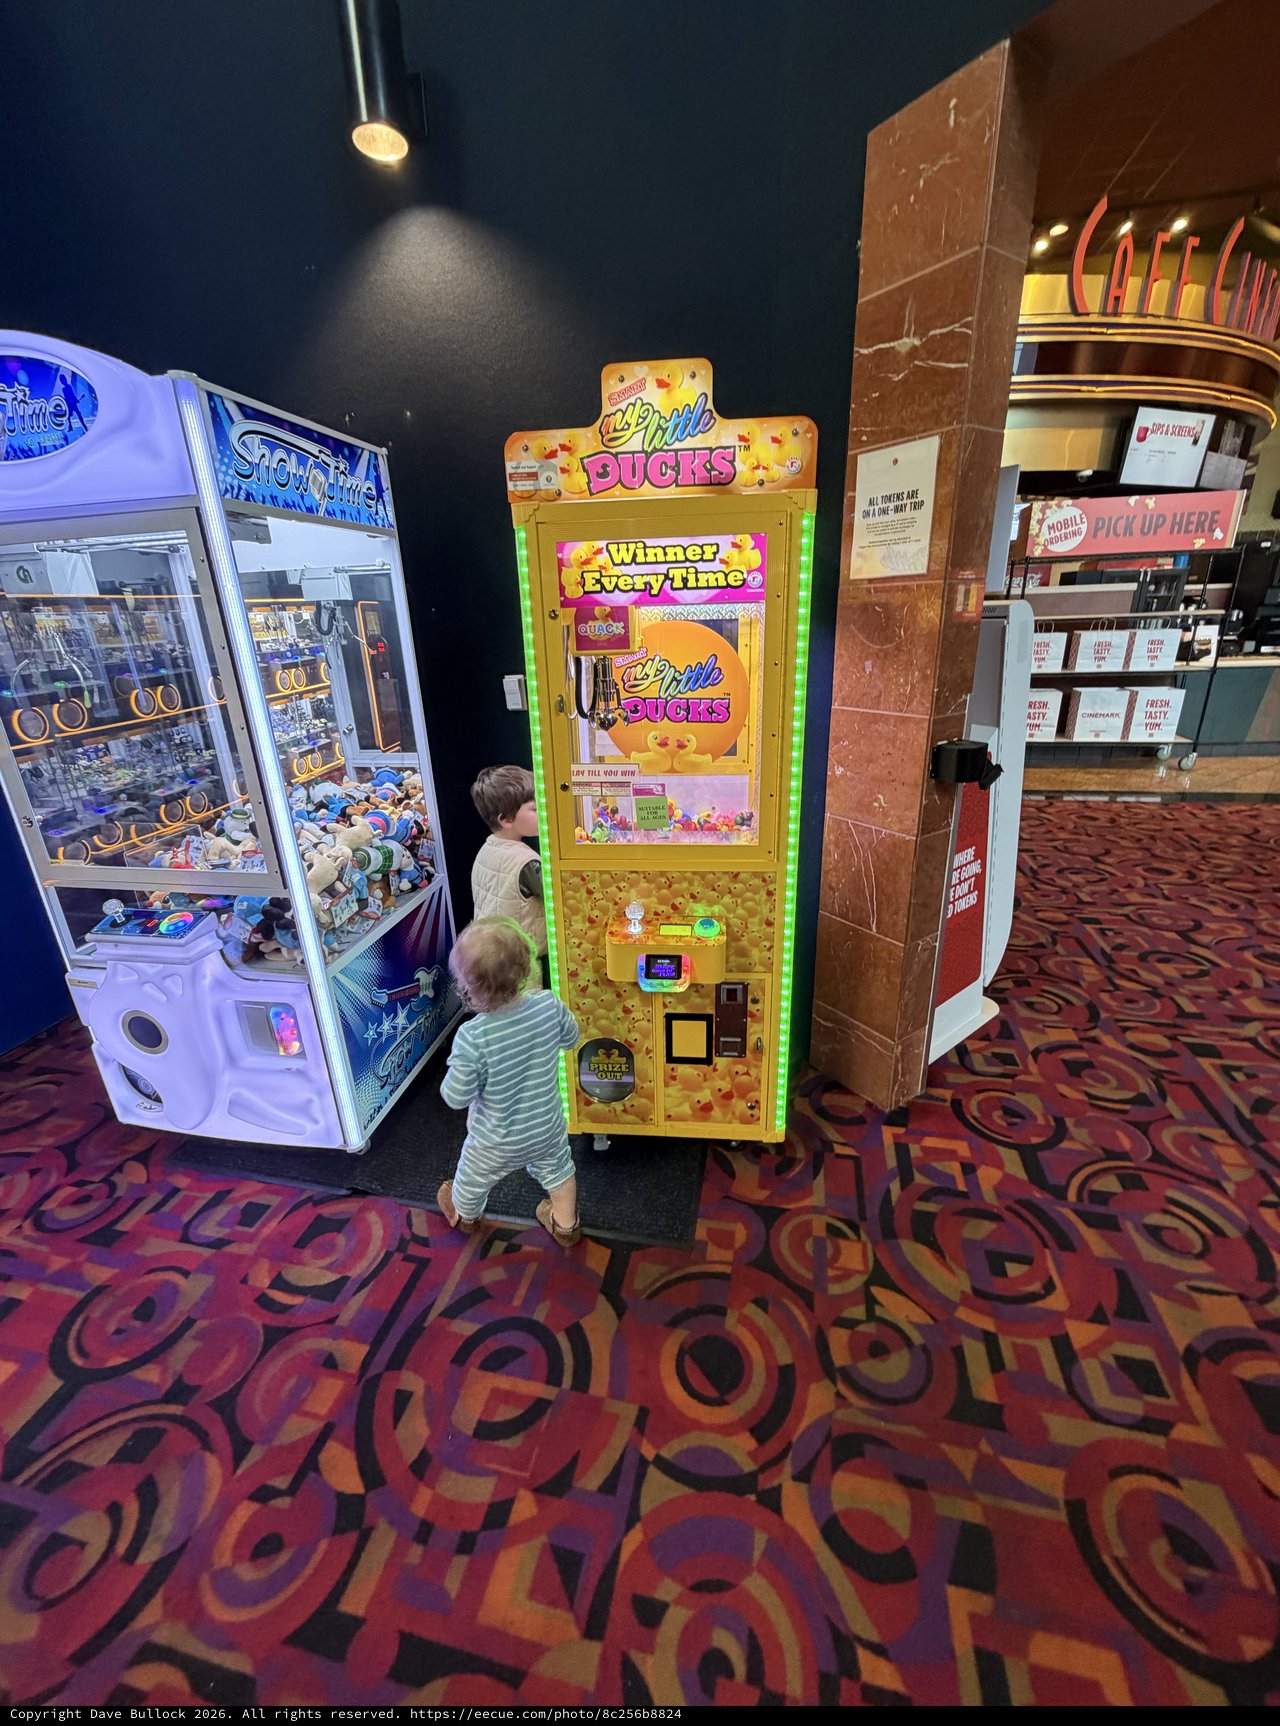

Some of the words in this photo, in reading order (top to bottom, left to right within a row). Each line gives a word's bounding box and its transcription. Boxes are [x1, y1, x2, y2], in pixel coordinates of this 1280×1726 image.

[608, 377, 646, 406] SMART
[600, 397, 655, 449] my
[643, 392, 716, 451] little
[1151, 422, 1165, 435] SIPS
[229, 419, 318, 495] Show
[319, 450, 376, 510] Time
[581, 445, 736, 496] DUCKS
[868, 496, 879, 507] ALL
[881, 491, 905, 505] TOKENS
[906, 488, 919, 501] ARE
[861, 508, 871, 519] ON
[871, 507, 876, 518] A
[877, 502, 908, 517] ONE-WAY
[910, 500, 925, 512] TRIP
[1047, 513, 1086, 536] MOBILE
[1092, 514, 1137, 539] PICK
[1140, 513, 1167, 537] UP
[1169, 510, 1221, 535] HERE
[1044, 527, 1083, 547] ORDERING
[607, 541, 718, 565] Winner
[582, 570, 666, 597] Every
[667, 566, 745, 590] Time
[578, 622, 625, 637] QUACK
[1093, 648, 1111, 656] TASTY.
[1094, 640, 1113, 648] FRESH.
[1147, 646, 1163, 654] TASTY.
[614, 647, 648, 668] SMART
[621, 654, 670, 693] my
[659, 654, 724, 698] little
[621, 696, 730, 724] DUCKS
[1028, 701, 1050, 710] RESH.
[1145, 699, 1172, 708] FRESH.
[1027, 711, 1047, 721] ASTY.
[1144, 711, 1169, 720] TASTY.
[1144, 722, 1163, 731] YUM.
[961, 859, 982, 880] GOING,
[954, 877, 975, 900] DON'T
[954, 890, 978, 915] TOKENS
[589, 1063, 629, 1071] PRIZE
[596, 1071, 623, 1080] OUT
